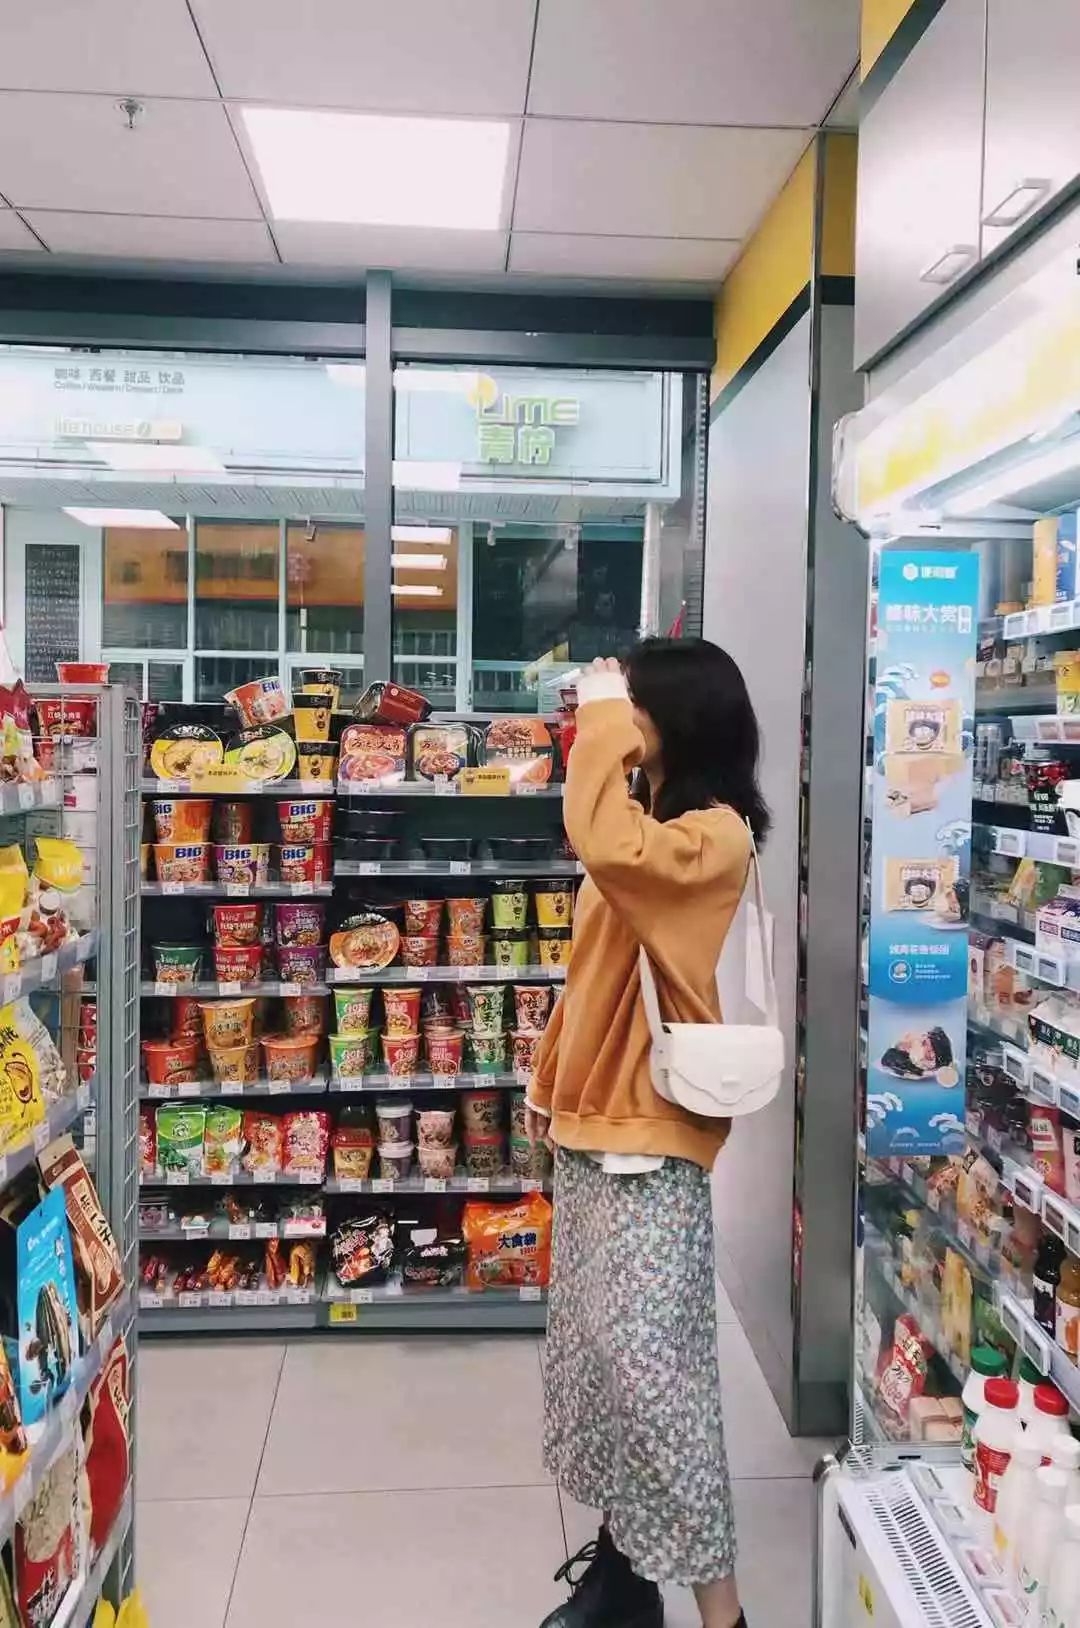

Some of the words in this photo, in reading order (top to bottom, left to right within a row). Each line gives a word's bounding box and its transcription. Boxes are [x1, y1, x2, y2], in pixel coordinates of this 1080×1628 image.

[89, 368, 116, 382] 西餐
[123, 370, 151, 384] 甜品
[158, 371, 185, 386] 饮品
[289, 803, 317, 817] BIG
[175, 846, 203, 860] BIG
[223, 847, 252, 861] BIG
[282, 847, 307, 861] BIG
